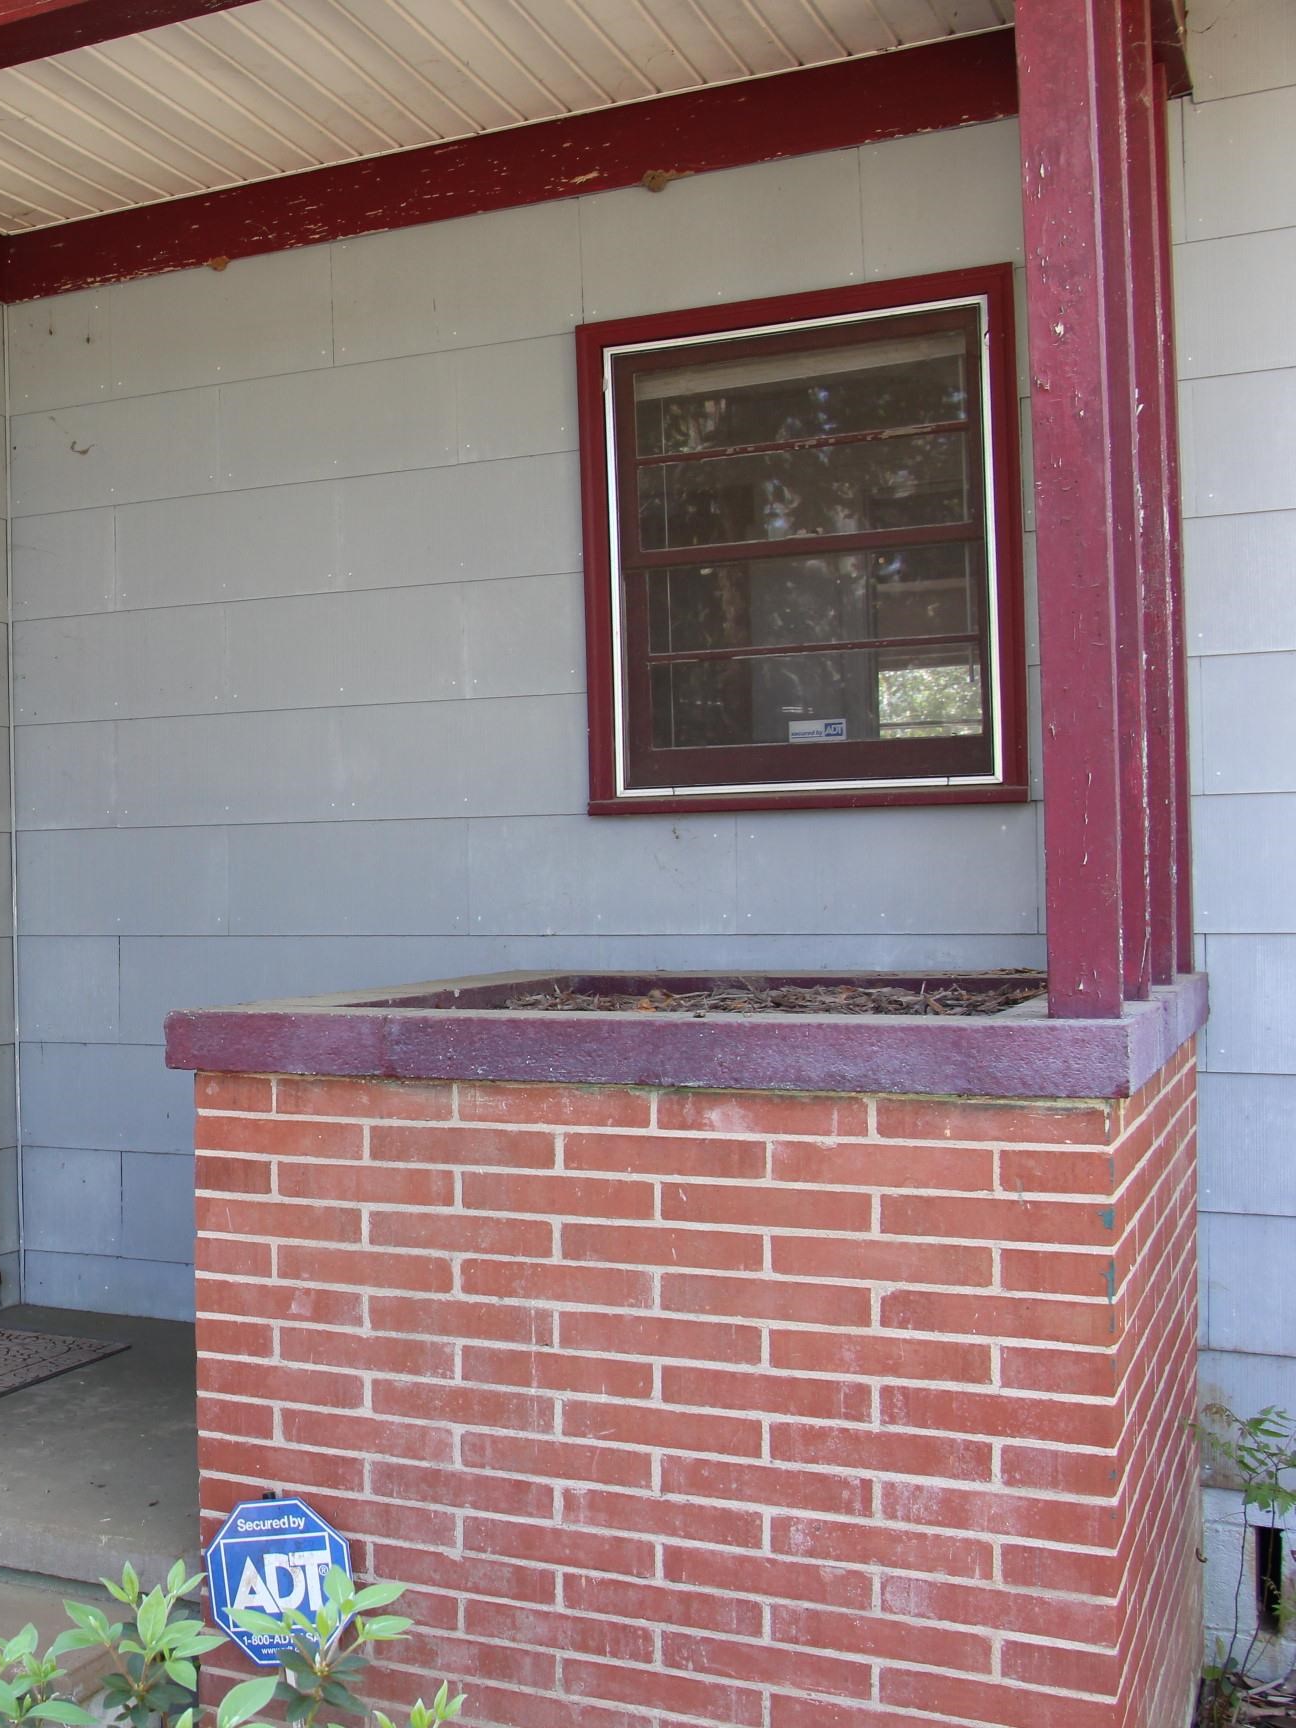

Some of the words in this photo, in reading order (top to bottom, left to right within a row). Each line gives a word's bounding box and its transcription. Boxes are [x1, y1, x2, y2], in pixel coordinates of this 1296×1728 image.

[825, 724, 843, 736] ADT
[236, 1515, 289, 1532] Secured
[289, 1514, 306, 1530] by
[231, 1550, 332, 1614] ADT
